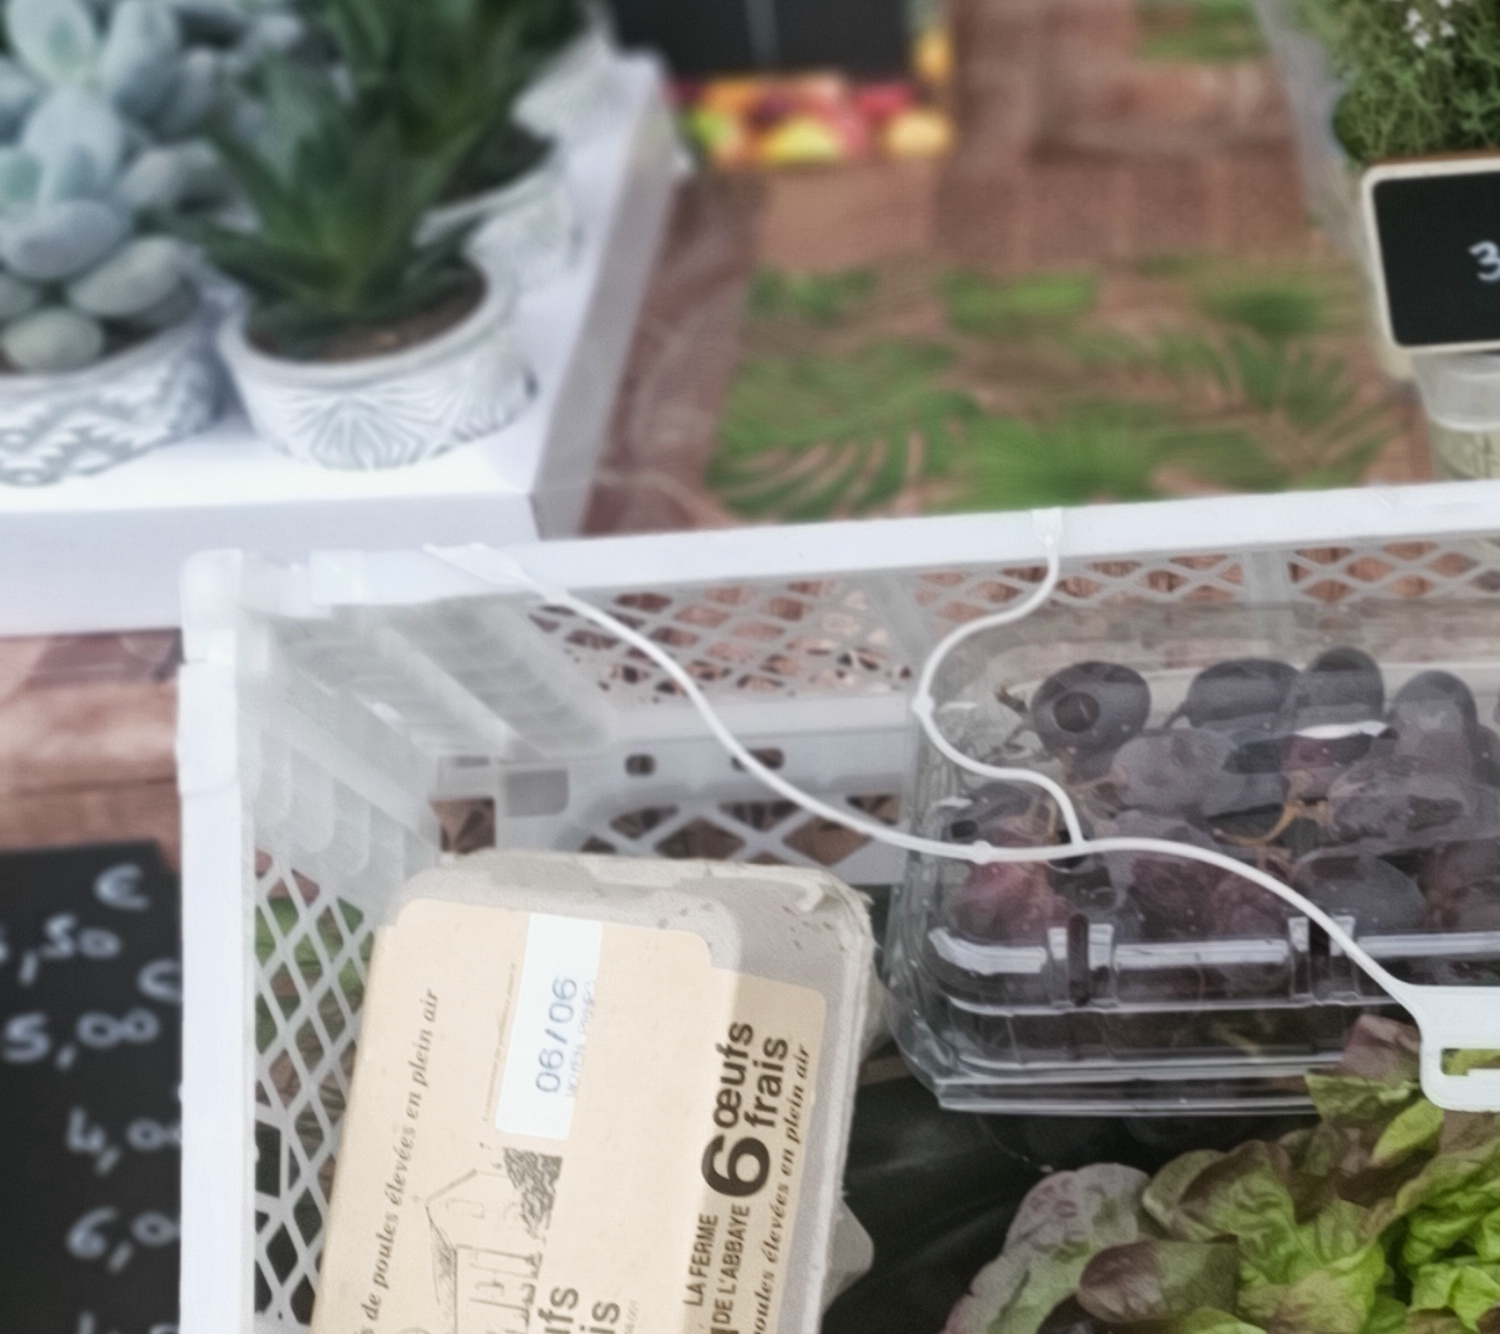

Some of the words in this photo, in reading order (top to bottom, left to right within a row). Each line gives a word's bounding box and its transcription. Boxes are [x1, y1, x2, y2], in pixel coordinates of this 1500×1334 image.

[0, 913, 123, 987] ,50
[422, 988, 438, 1024] air
[535, 978, 577, 1093] 06/06
[2, 1011, 161, 1069] 5,00
[408, 1029, 433, 1088] plein
[793, 1044, 810, 1080] air
[406, 1091, 422, 1120] en
[713, 1021, 756, 1130] œufs
[743, 1038, 788, 1128] frais
[782, 1085, 804, 1145] plein
[384, 1127, 415, 1206] élevées
[701, 1135, 771, 1198] 6
[780, 1148, 795, 1177] en
[372, 1213, 398, 1290] poules
[689, 1215, 718, 1278] FERME
[718, 1205, 750, 1295] L'ABBAYE
[761, 1183, 789, 1264] élevées
[360, 1293, 382, 1322] de
[684, 1281, 707, 1308] LA
[711, 1299, 734, 1325] DE
